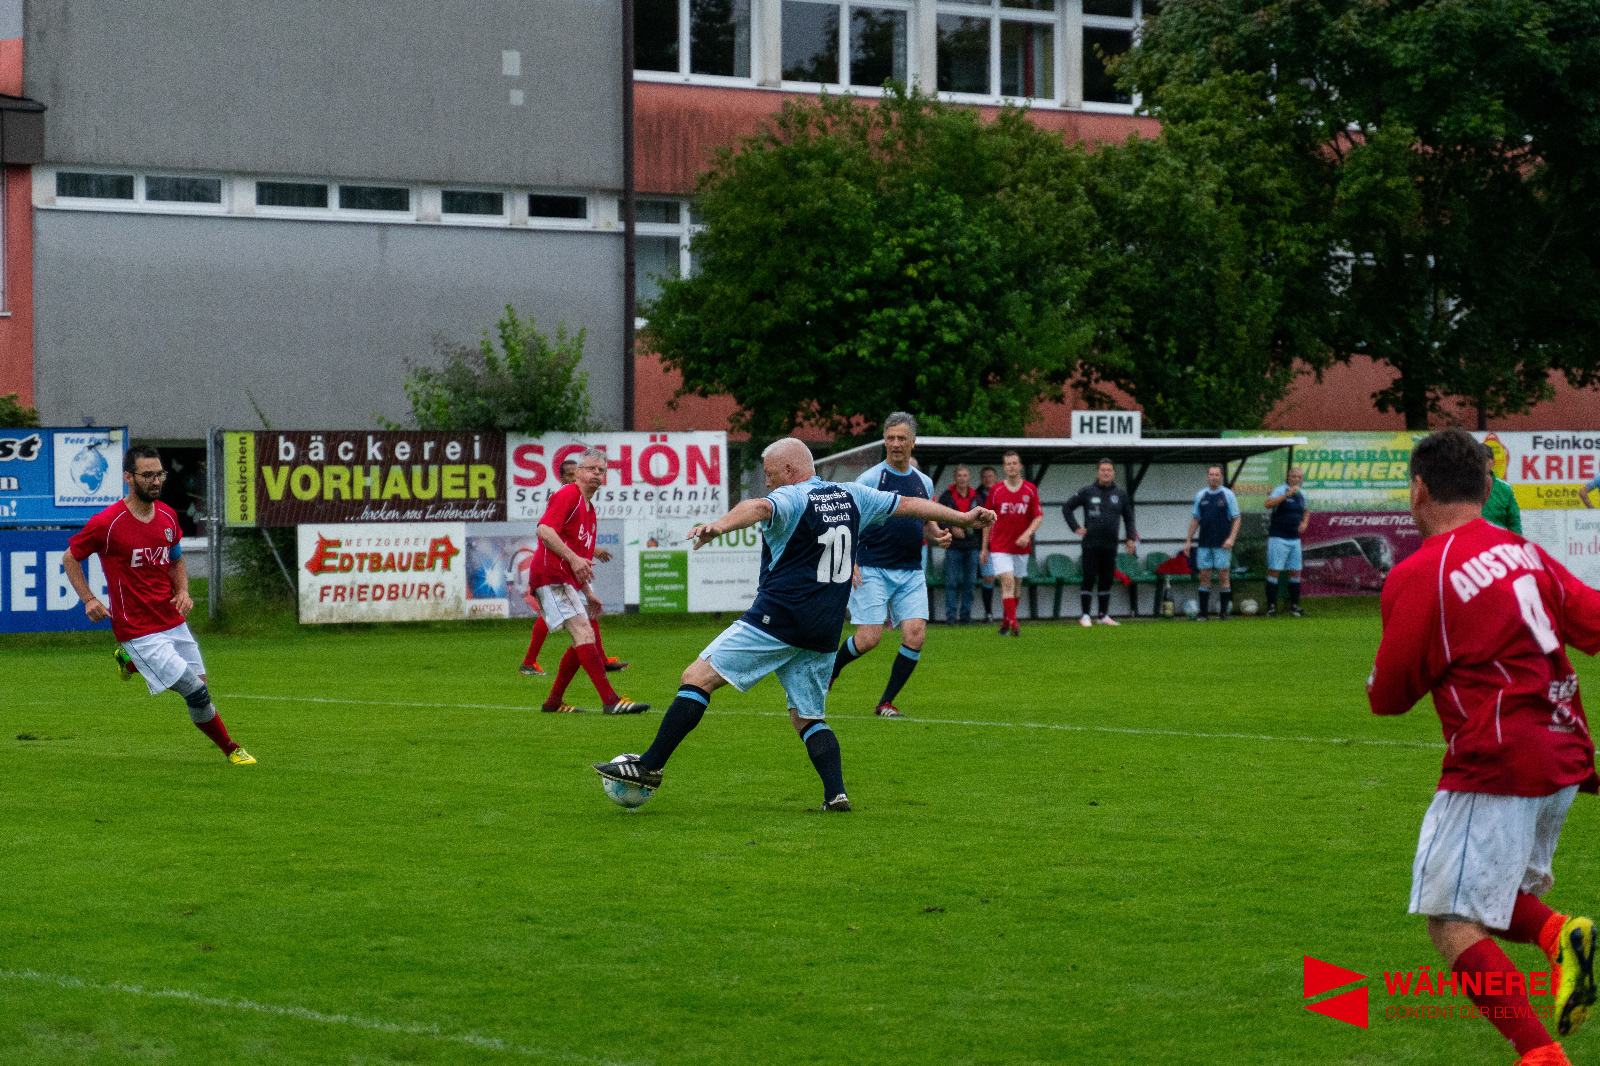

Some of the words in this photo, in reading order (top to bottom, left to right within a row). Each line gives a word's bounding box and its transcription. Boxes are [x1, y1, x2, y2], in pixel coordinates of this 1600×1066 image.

[1079, 415, 1133, 435] HEIM
[64, 436, 85, 445] Tele
[278, 435, 481, 461] bäckerei
[512, 434, 721, 487] SCHÖN
[1521, 454, 1600, 480] KRIE
[236, 436, 248, 521] seekirchen
[261, 464, 497, 501] VORHAUER
[515, 487, 720, 502] Schisstechnik
[424, 500, 496, 521] Leidenschaft
[1000, 502, 1029, 515] EVN
[344, 537, 428, 547] METZGEREI
[1568, 536, 1583, 556] in
[130, 546, 170, 567] EVN
[304, 531, 460, 576] EDTBAUER
[816, 524, 852, 584] 10
[319, 583, 446, 602] FRIEDBURG
